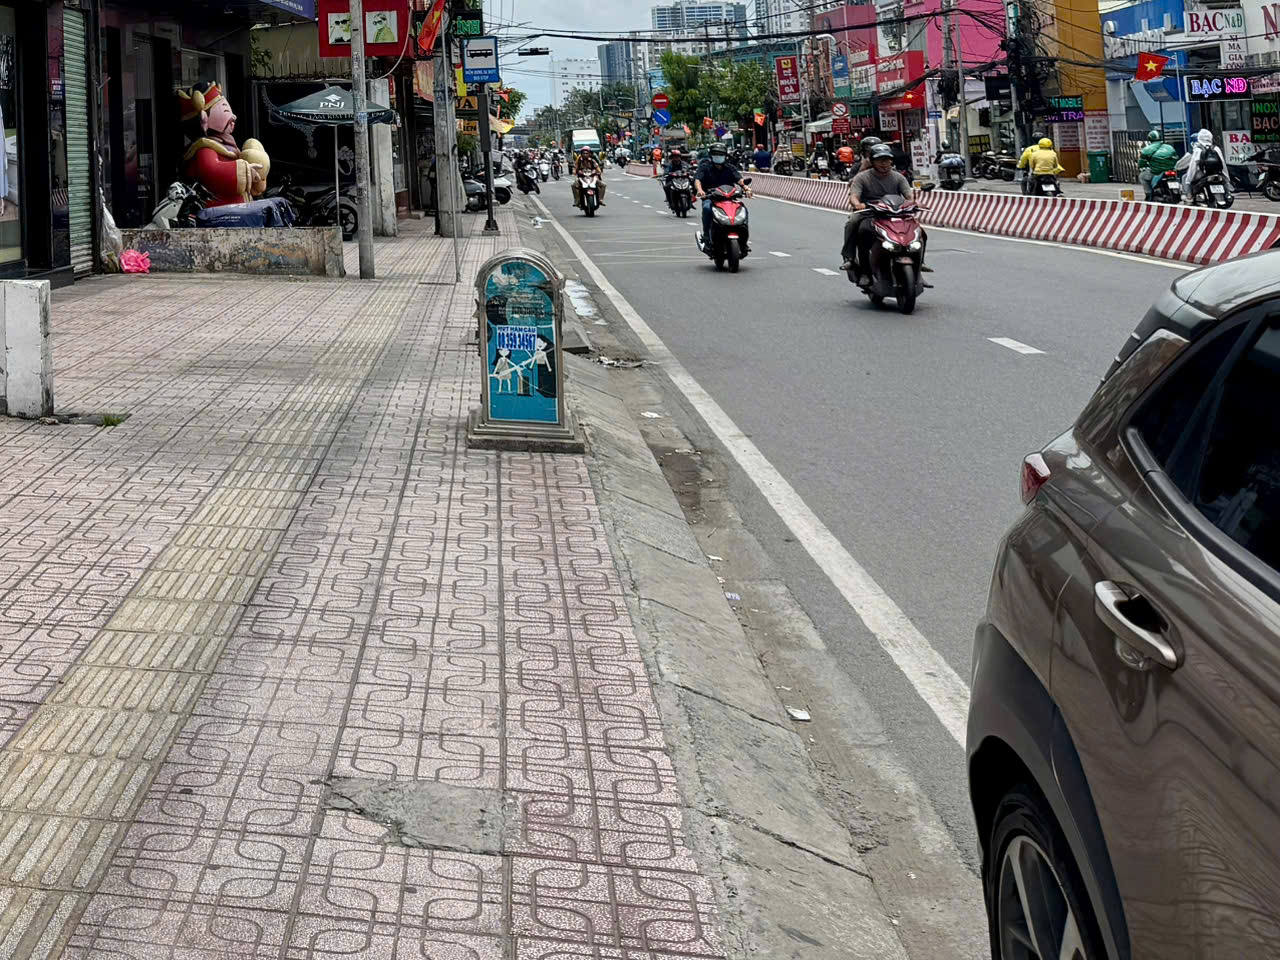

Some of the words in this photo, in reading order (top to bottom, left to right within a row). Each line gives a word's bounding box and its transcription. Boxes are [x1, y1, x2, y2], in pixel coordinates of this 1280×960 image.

[1188, 12, 1224, 34] BẠC
[1191, 79, 1222, 98] BẠC
[1252, 102, 1277, 113] INOX
[1253, 117, 1279, 132] BẠC
